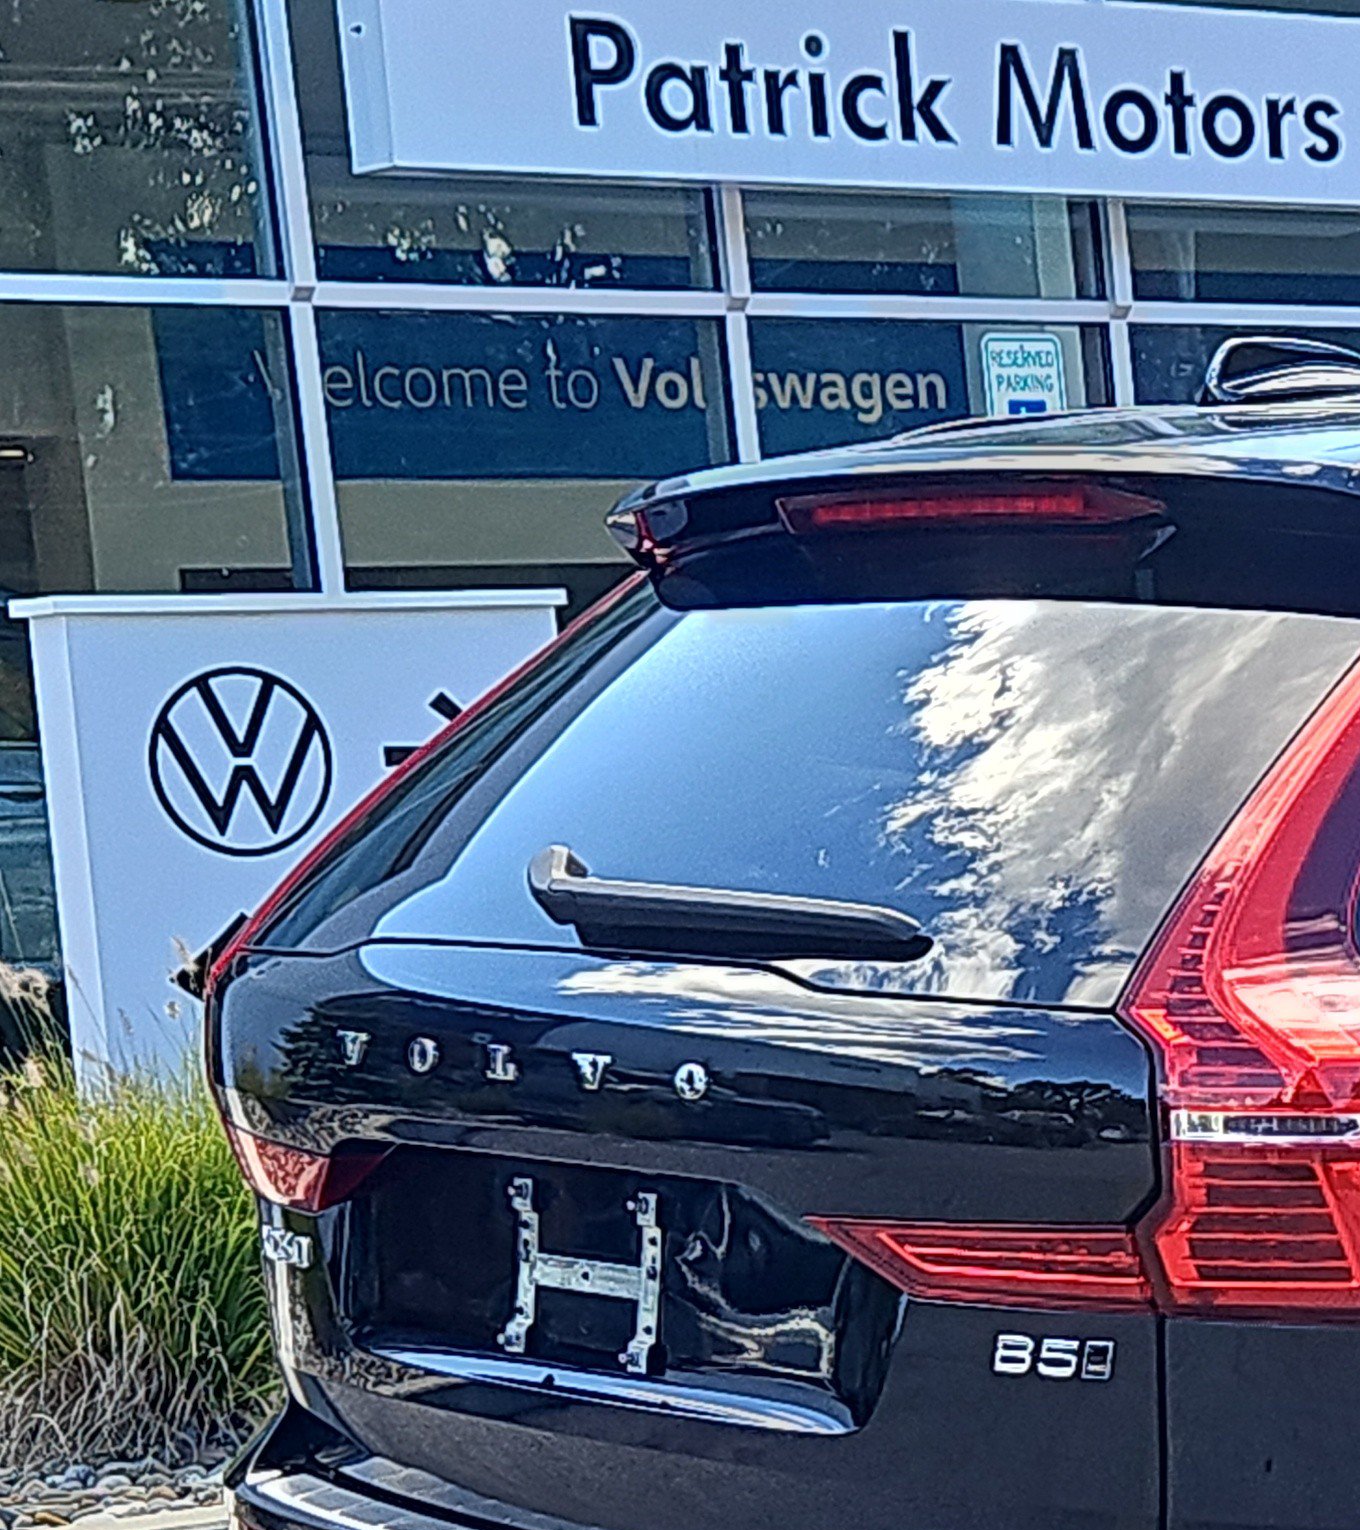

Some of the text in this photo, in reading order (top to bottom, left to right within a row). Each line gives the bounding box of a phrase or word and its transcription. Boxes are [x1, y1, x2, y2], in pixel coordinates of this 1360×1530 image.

[568, 17, 1342, 162] Patrick Motors
[253, 349, 947, 424] elcome to Volswagen
[990, 350, 1054, 368] RESERVED
[996, 373, 1054, 392] PARKING
[337, 1029, 710, 1101] VOLVO
